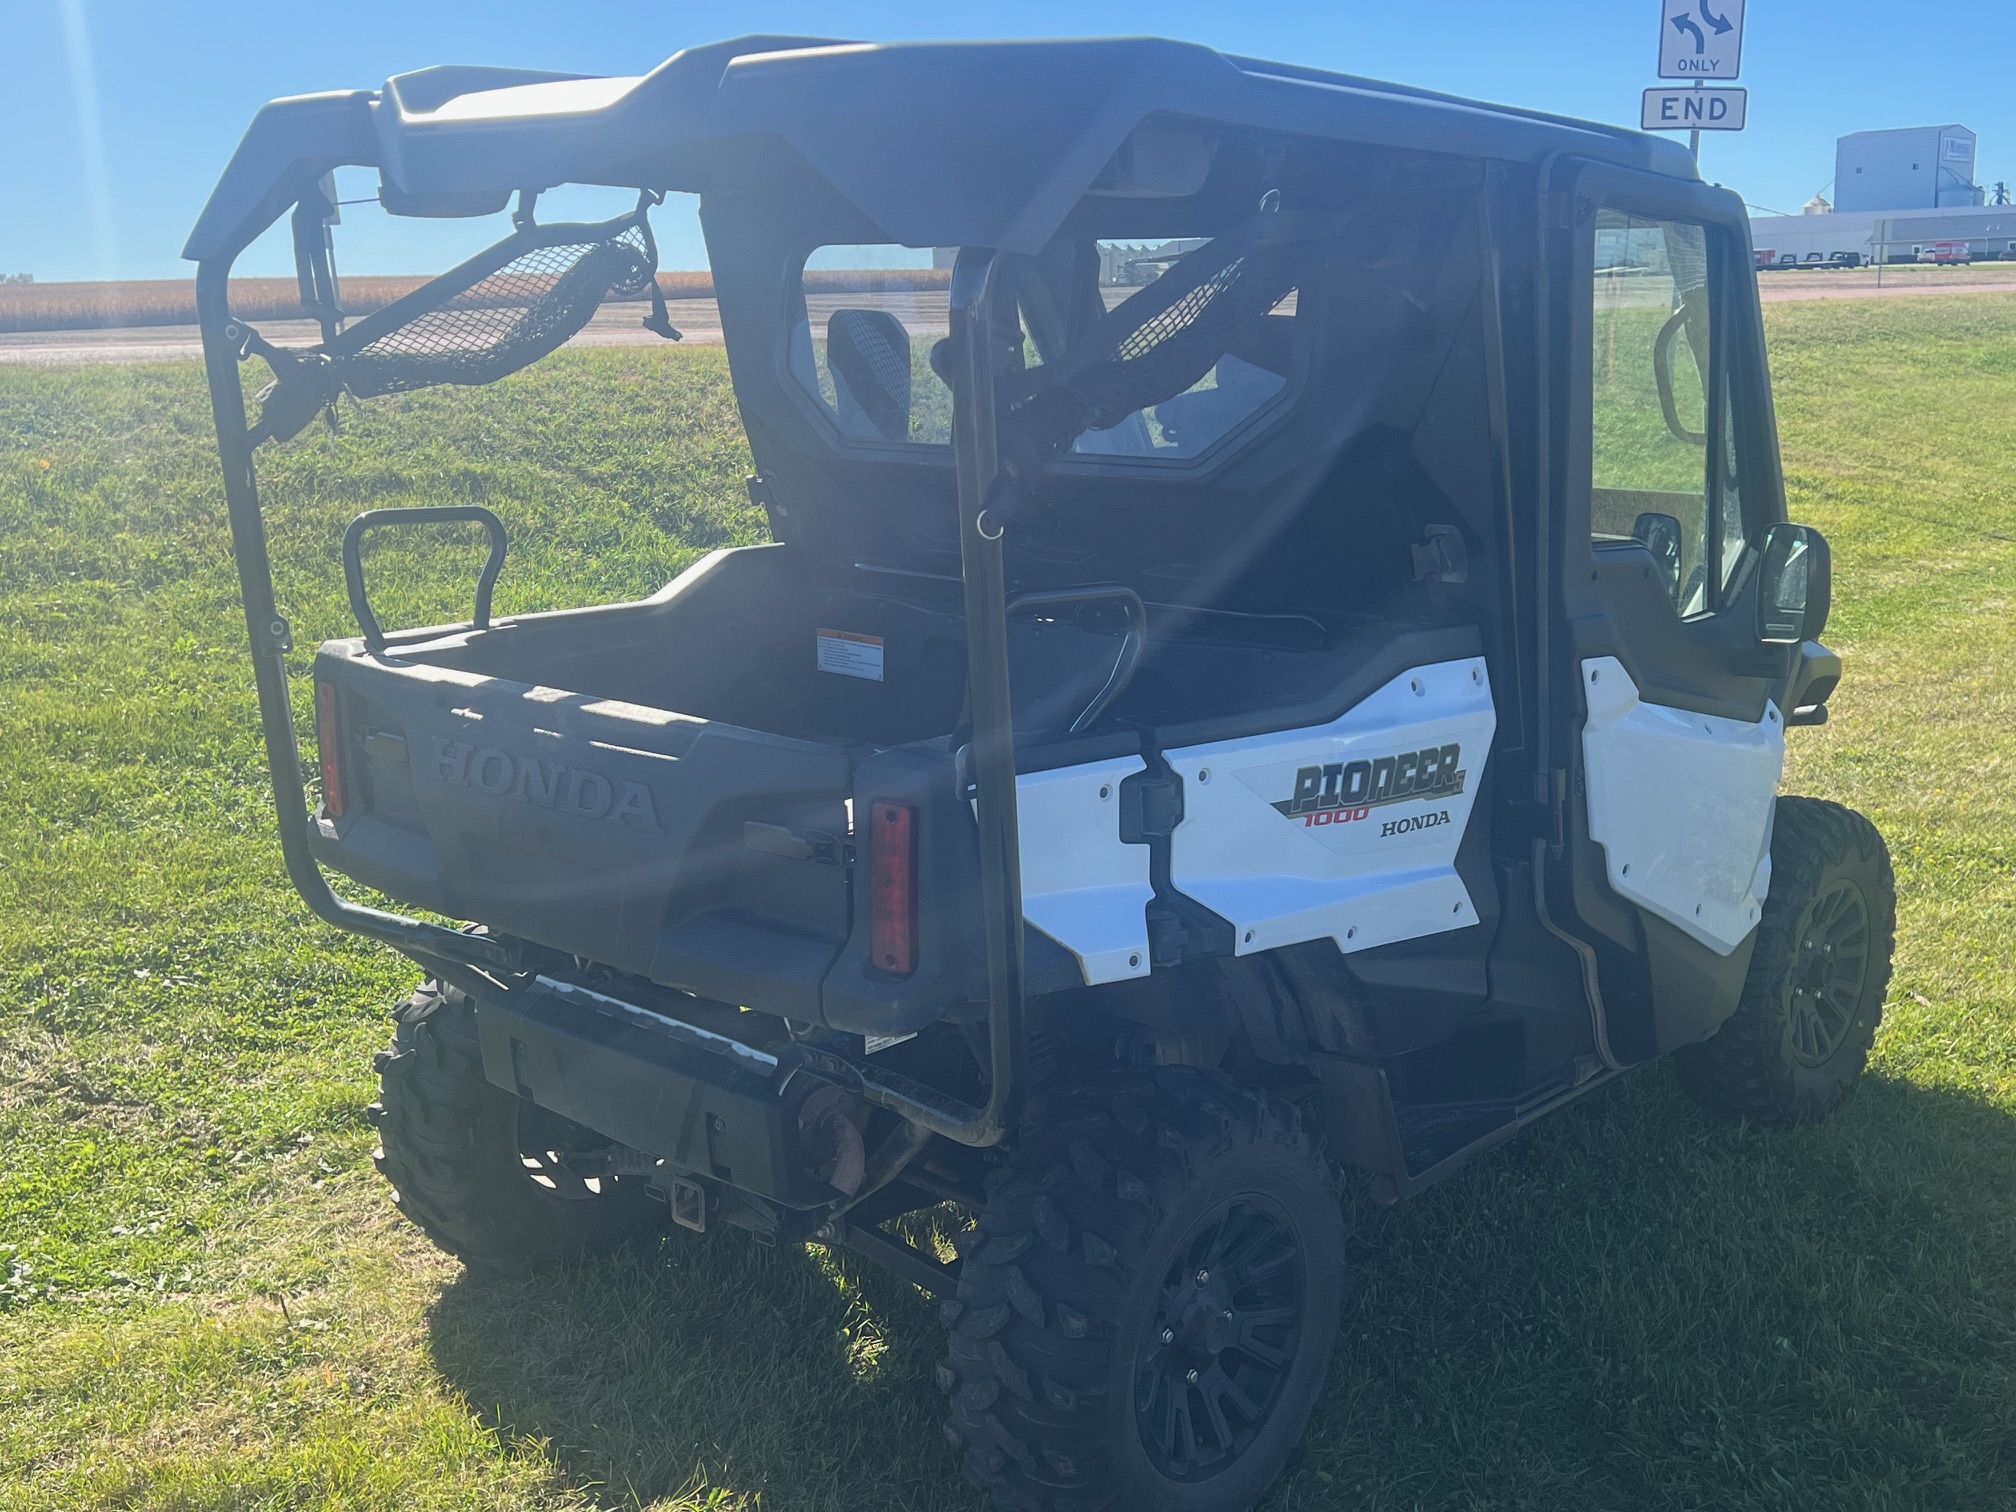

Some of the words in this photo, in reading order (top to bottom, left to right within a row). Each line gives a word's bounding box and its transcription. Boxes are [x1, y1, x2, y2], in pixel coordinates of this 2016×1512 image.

[1677, 59, 1720, 71] ONLY
[1661, 97, 1727, 120] END
[425, 736, 666, 836] HONDA
[1290, 743, 1460, 813] PIONEER
[1305, 806, 1369, 827] 1000
[1380, 810, 1450, 837] HONDA
